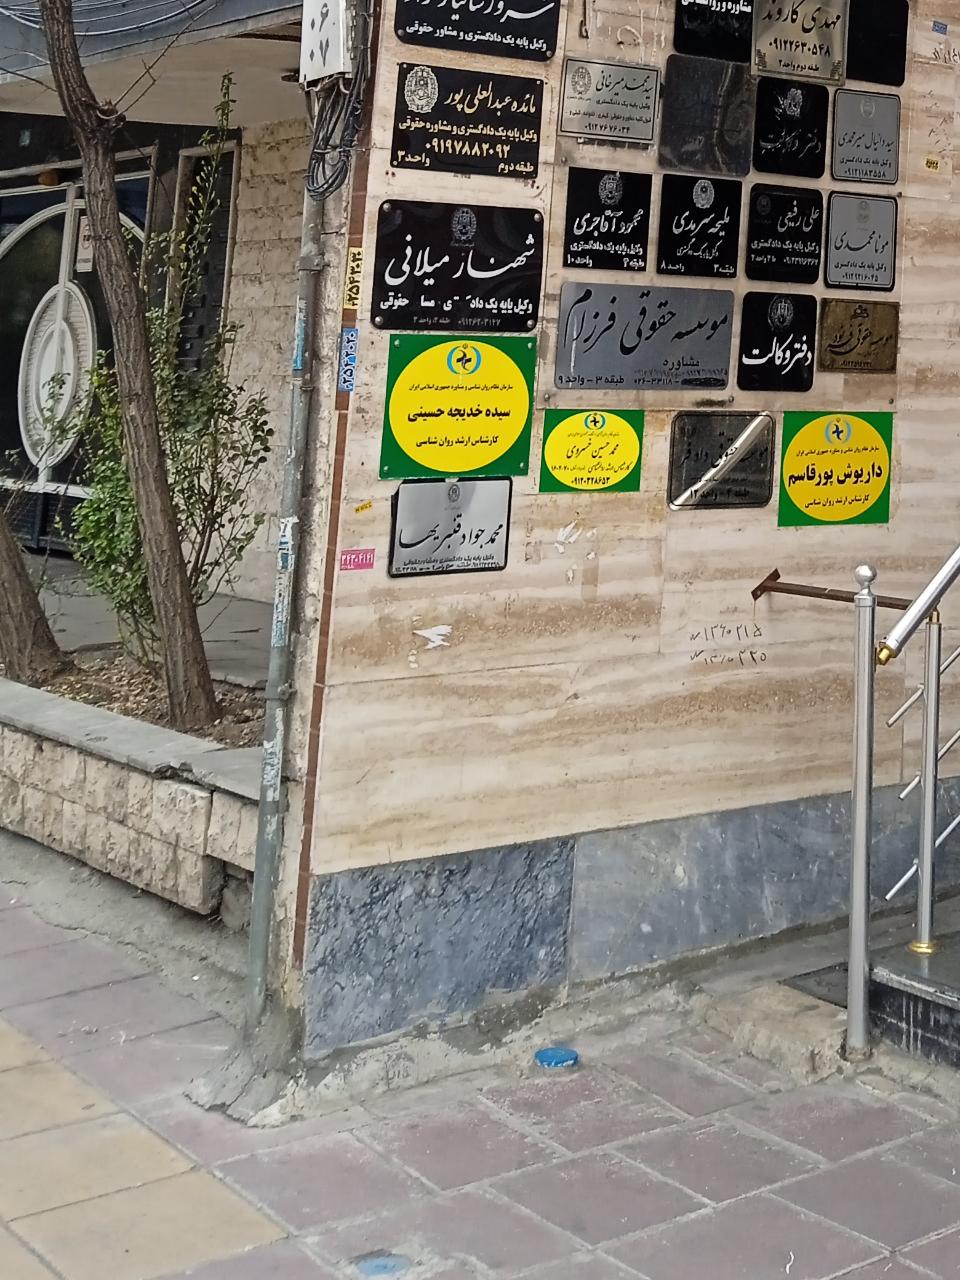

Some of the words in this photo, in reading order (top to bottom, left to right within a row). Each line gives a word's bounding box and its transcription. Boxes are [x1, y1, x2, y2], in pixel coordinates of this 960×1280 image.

[721, 1, 726, 10] و
[727, 0, 751, 14] مشاوره
[802, 7, 840, 33] مهدی
[406, 21, 433, 35] حقوقی
[434, 26, 457, 38] مشاور
[459, 32, 464, 40] و
[464, 31, 501, 42] دادگستری
[502, 35, 515, 46] یک
[516, 38, 528, 49] پایه
[530, 38, 546, 51] وکیل
[596, 70, 624, 96] میرخانی
[511, 93, 535, 113] مائده
[399, 116, 425, 131] حقوقی
[426, 120, 451, 133] مشاوره
[452, 126, 457, 135] و
[458, 124, 494, 136] دادگستری
[495, 127, 506, 140] یک
[507, 128, 520, 141] پایه
[520, 129, 537, 142] وکیل
[405, 153, 430, 166] واحد
[498, 162, 514, 172] دوم
[516, 164, 534, 174] طبقه
[618, 209, 643, 234] محمود
[803, 205, 820, 232] علی
[751, 239, 781, 249] دادگستری
[783, 241, 792, 251] یک
[834, 230, 875, 251] محمدی
[875, 235, 889, 254] مونا
[804, 244, 819, 254] وکیل
[385, 234, 450, 286] میلانی
[668, 262, 685, 272] واحد
[380, 292, 409, 310] حقوقی
[485, 297, 498, 313] یک
[514, 298, 532, 315] وکیل
[564, 288, 617, 354] فرزام
[619, 290, 676, 356] حقوقی
[671, 314, 728, 343] موسسه
[742, 333, 794, 365] وکالت
[782, 335, 812, 375] دفتر
[663, 356, 700, 371] مشاوره
[566, 375, 584, 386] واحد
[605, 374, 624, 386] طبقه
[408, 406, 445, 422] حسینی
[447, 404, 483, 421] خدیجه
[485, 407, 511, 421] سیده
[455, 436, 470, 446] ارشد
[471, 435, 499, 446] کارشناس
[836, 462, 882, 485] داریوش
[460, 528, 486, 549] جواد
[485, 524, 503, 545] محمد
